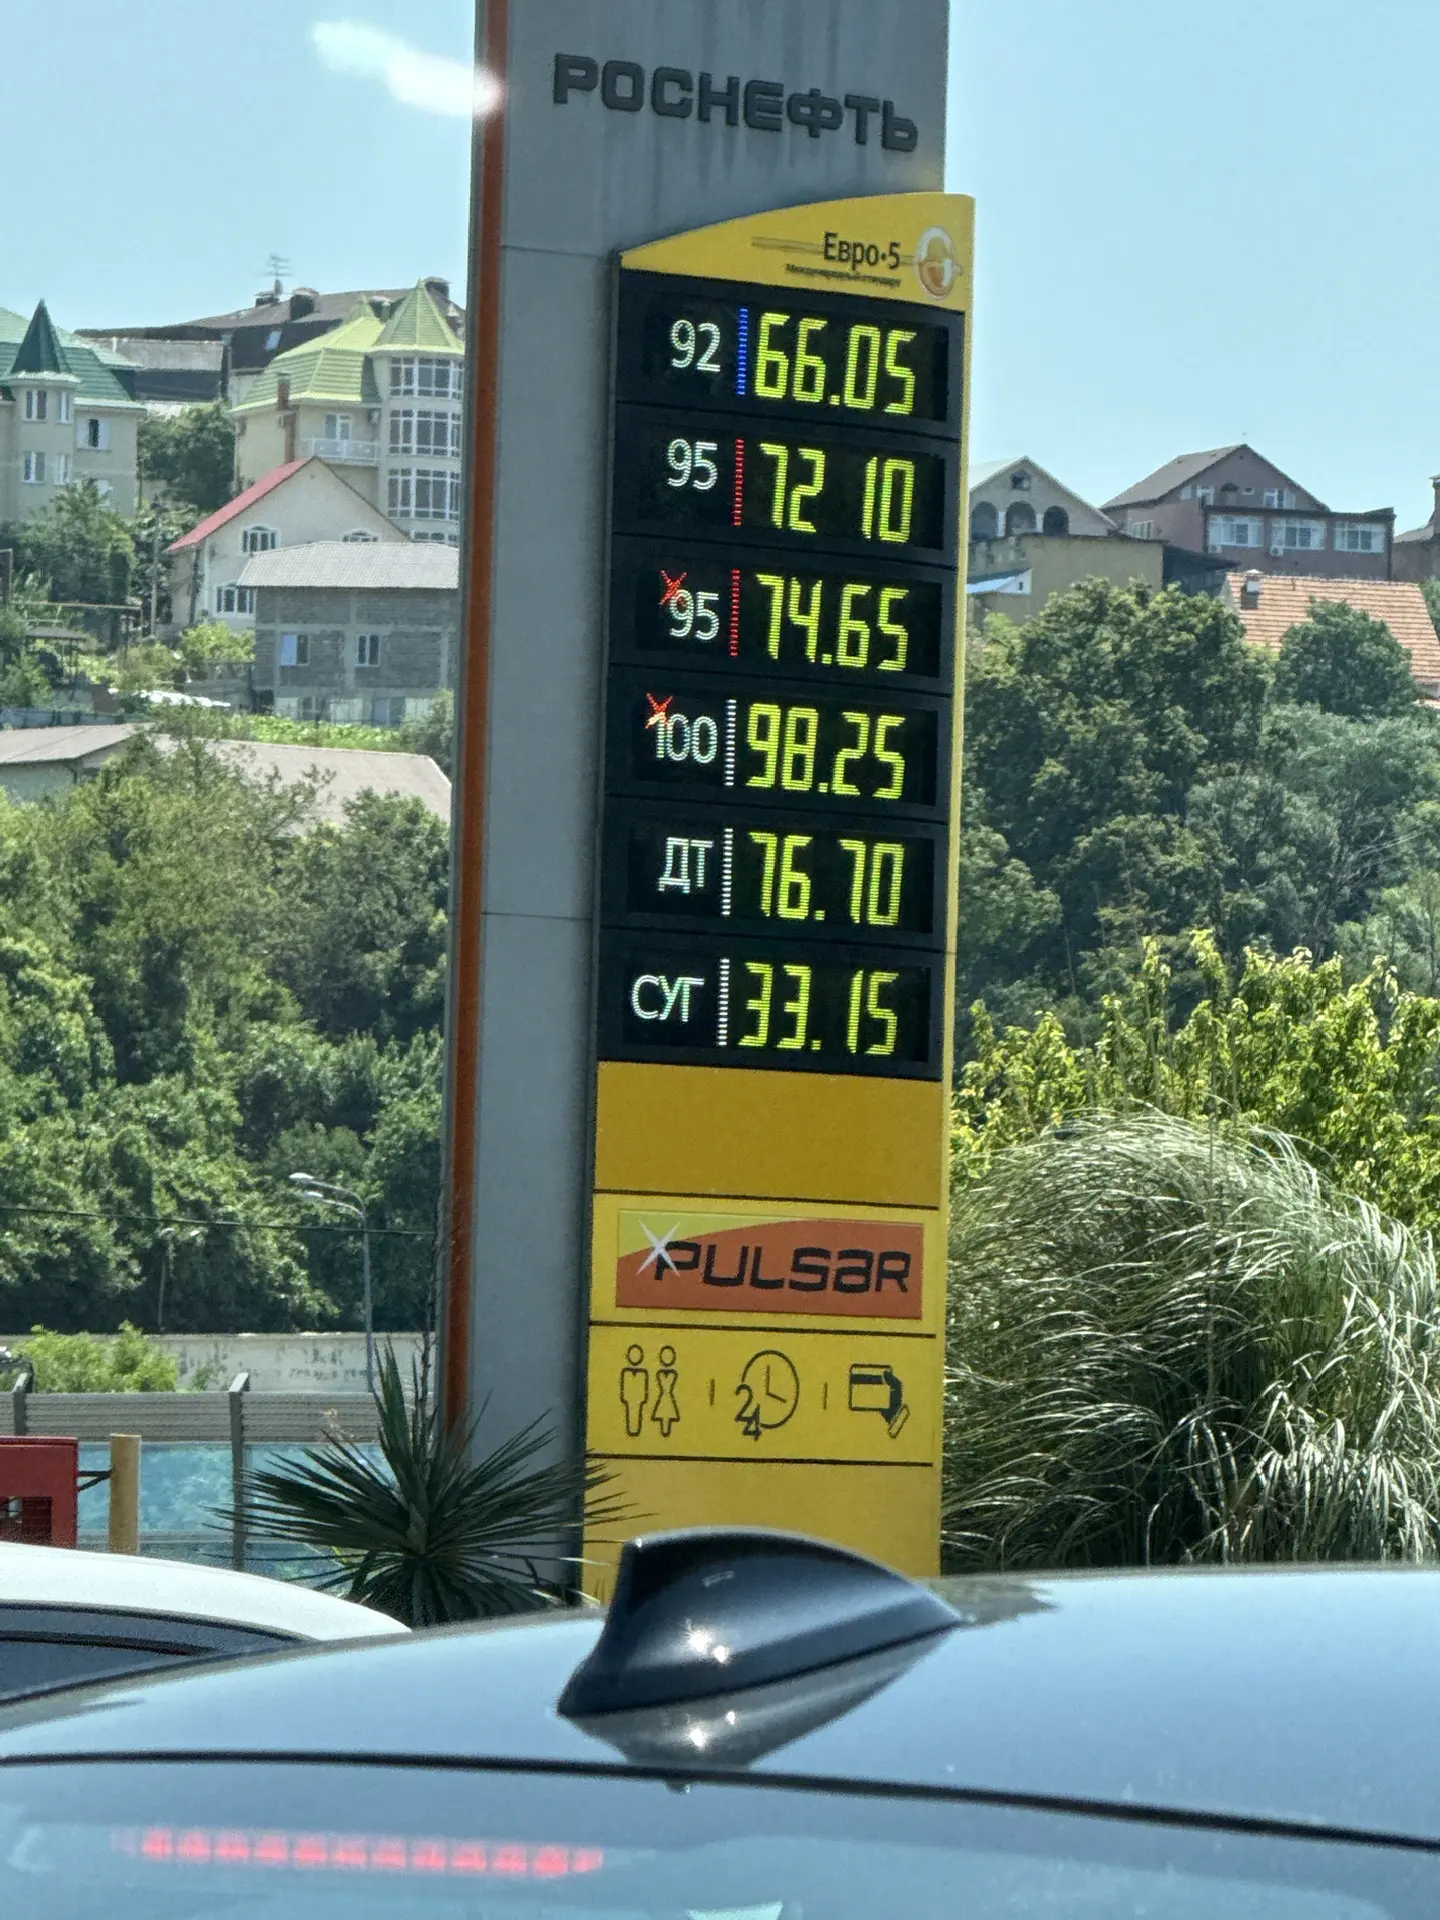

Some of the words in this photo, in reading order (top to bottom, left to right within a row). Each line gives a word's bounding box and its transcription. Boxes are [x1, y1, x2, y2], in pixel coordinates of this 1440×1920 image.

[553, 53, 918, 152] РОСНЕФТЬ
[670, 319, 721, 372] 92
[755, 312, 917, 415] 66.05
[666, 438, 718, 490] 95
[667, 589, 719, 640] 95
[756, 573, 909, 673] 74.65
[652, 713, 718, 764] 100
[744, 702, 906, 799] 98.25
[658, 836, 714, 893] ДТ
[631, 974, 704, 1022] СУГ
